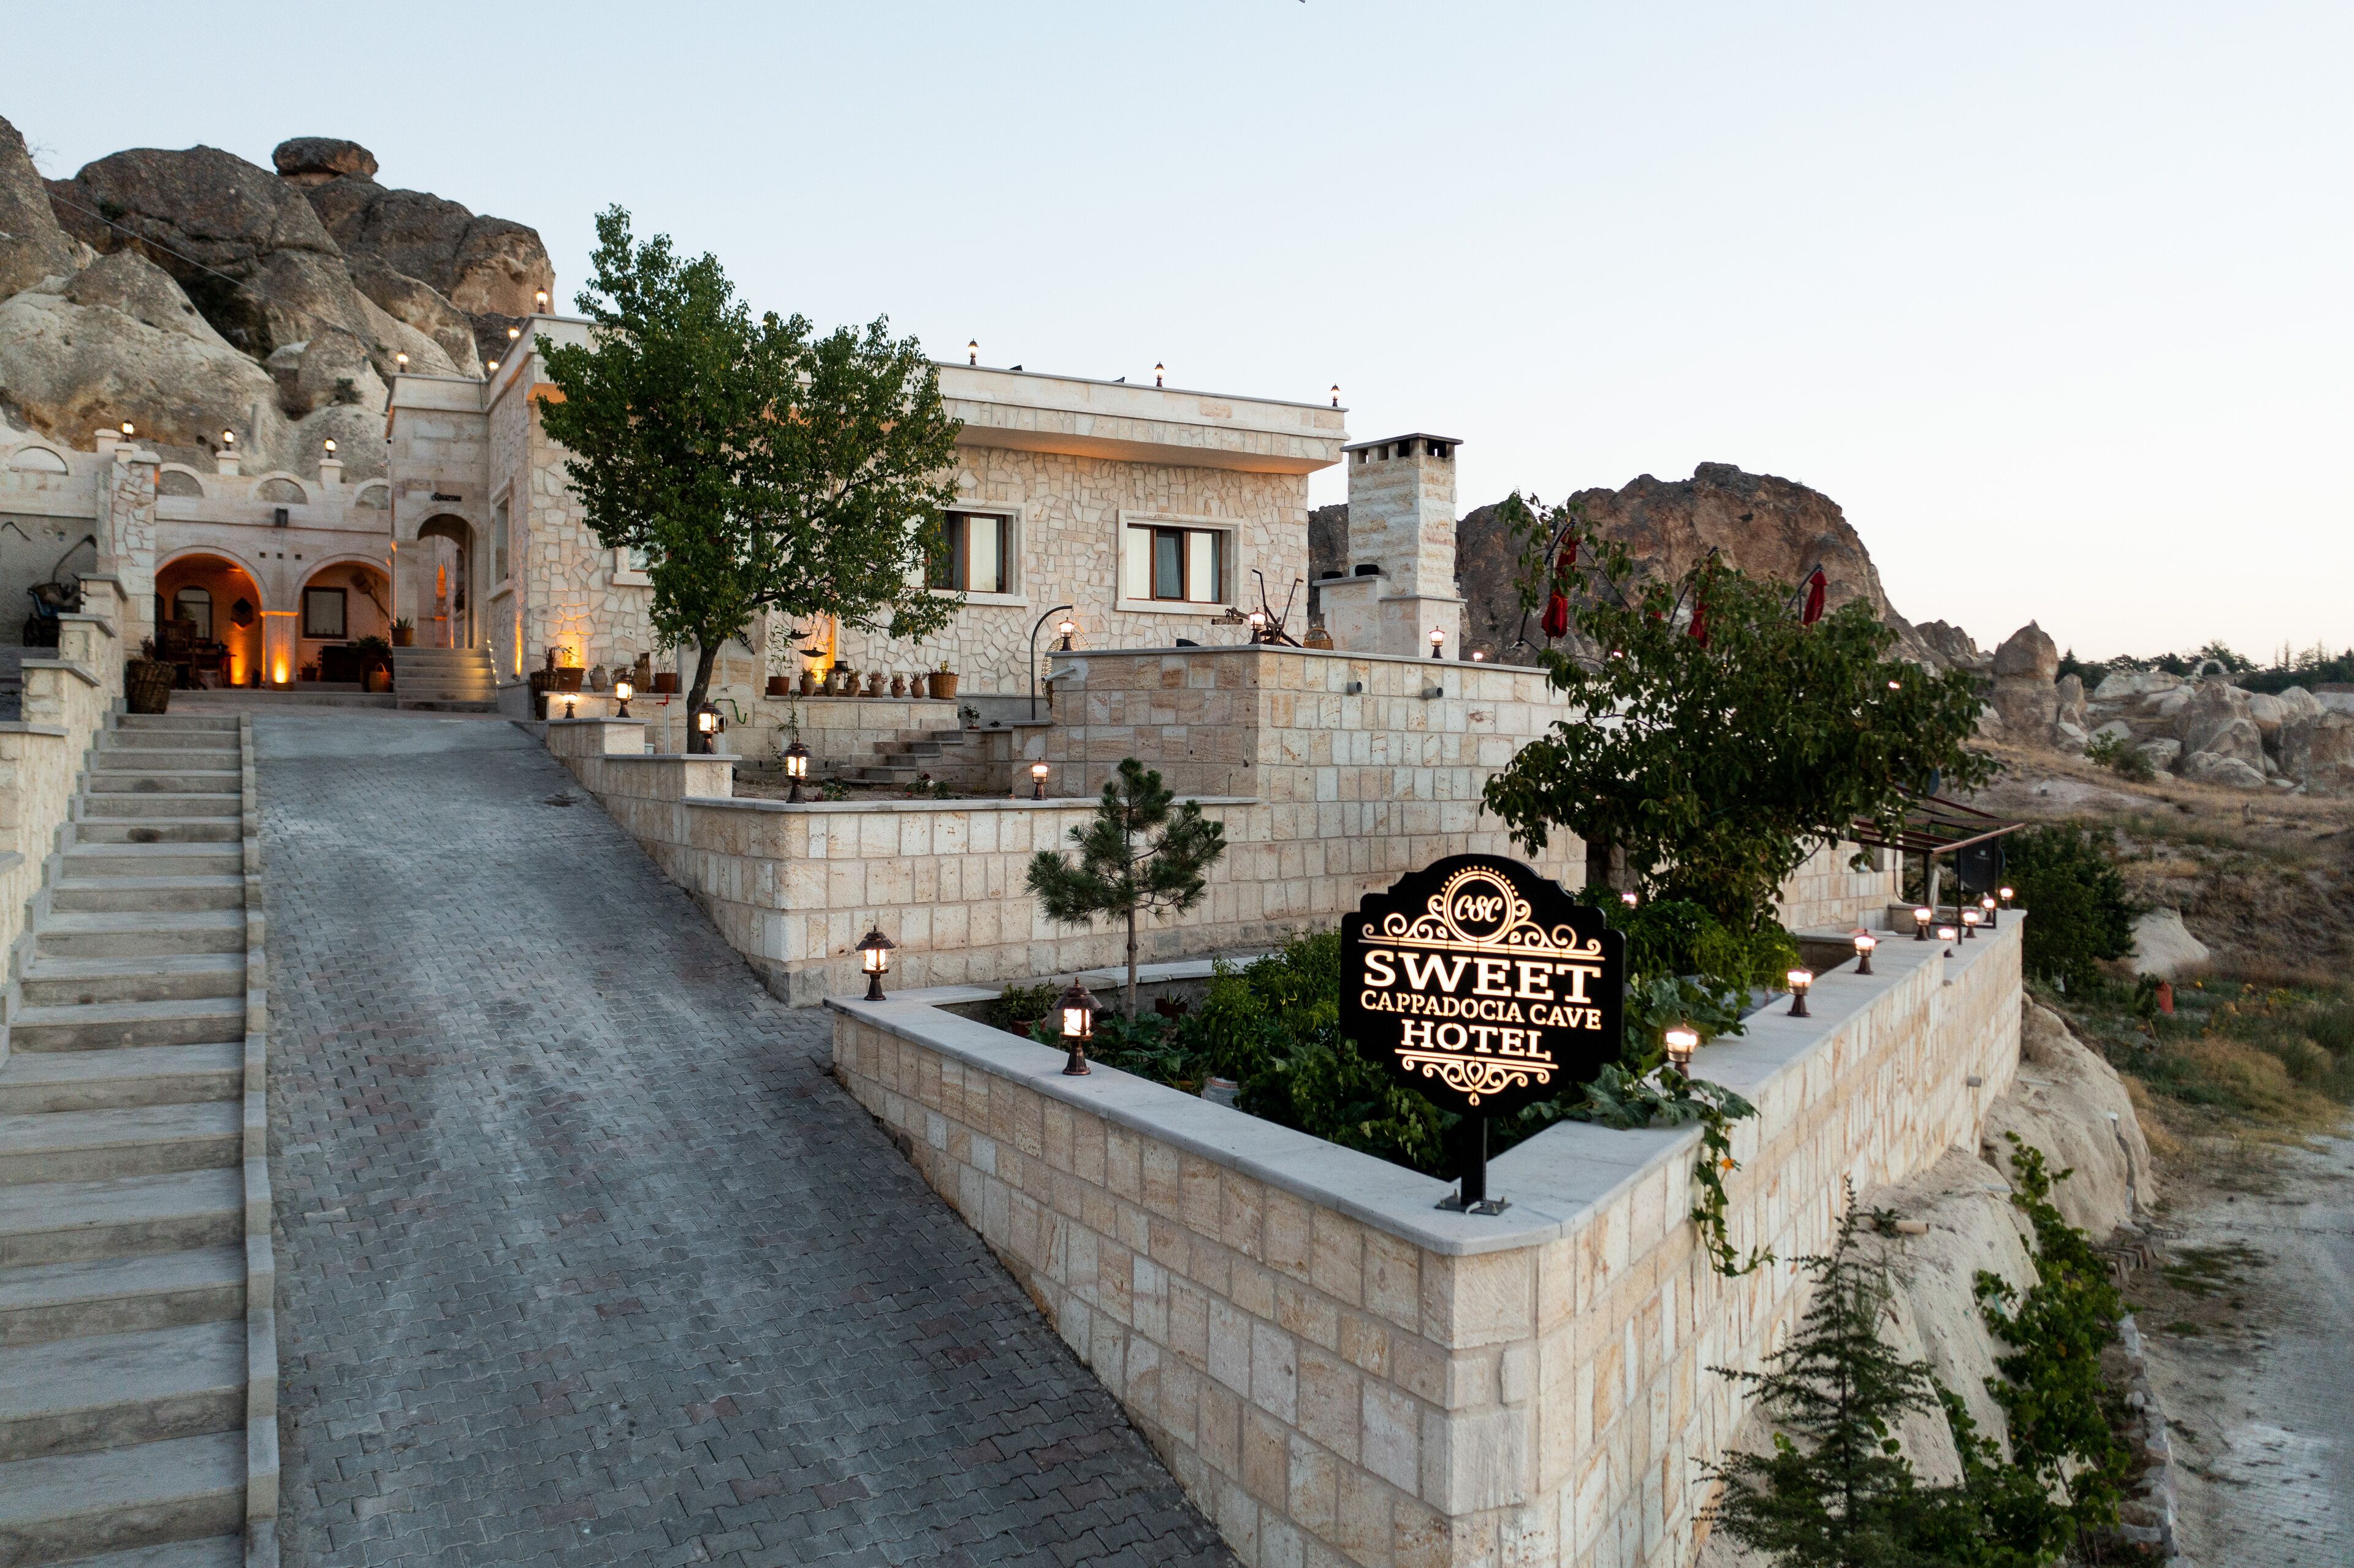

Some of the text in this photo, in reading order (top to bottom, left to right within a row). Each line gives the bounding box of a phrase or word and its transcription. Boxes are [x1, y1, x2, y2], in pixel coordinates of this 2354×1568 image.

[1454, 896, 1503, 922] CSC
[1364, 950, 1601, 1003] SWEET
[1361, 989, 1601, 1030] CAPPADOCIA CAVE
[1401, 1019, 1552, 1061] HOTEL
